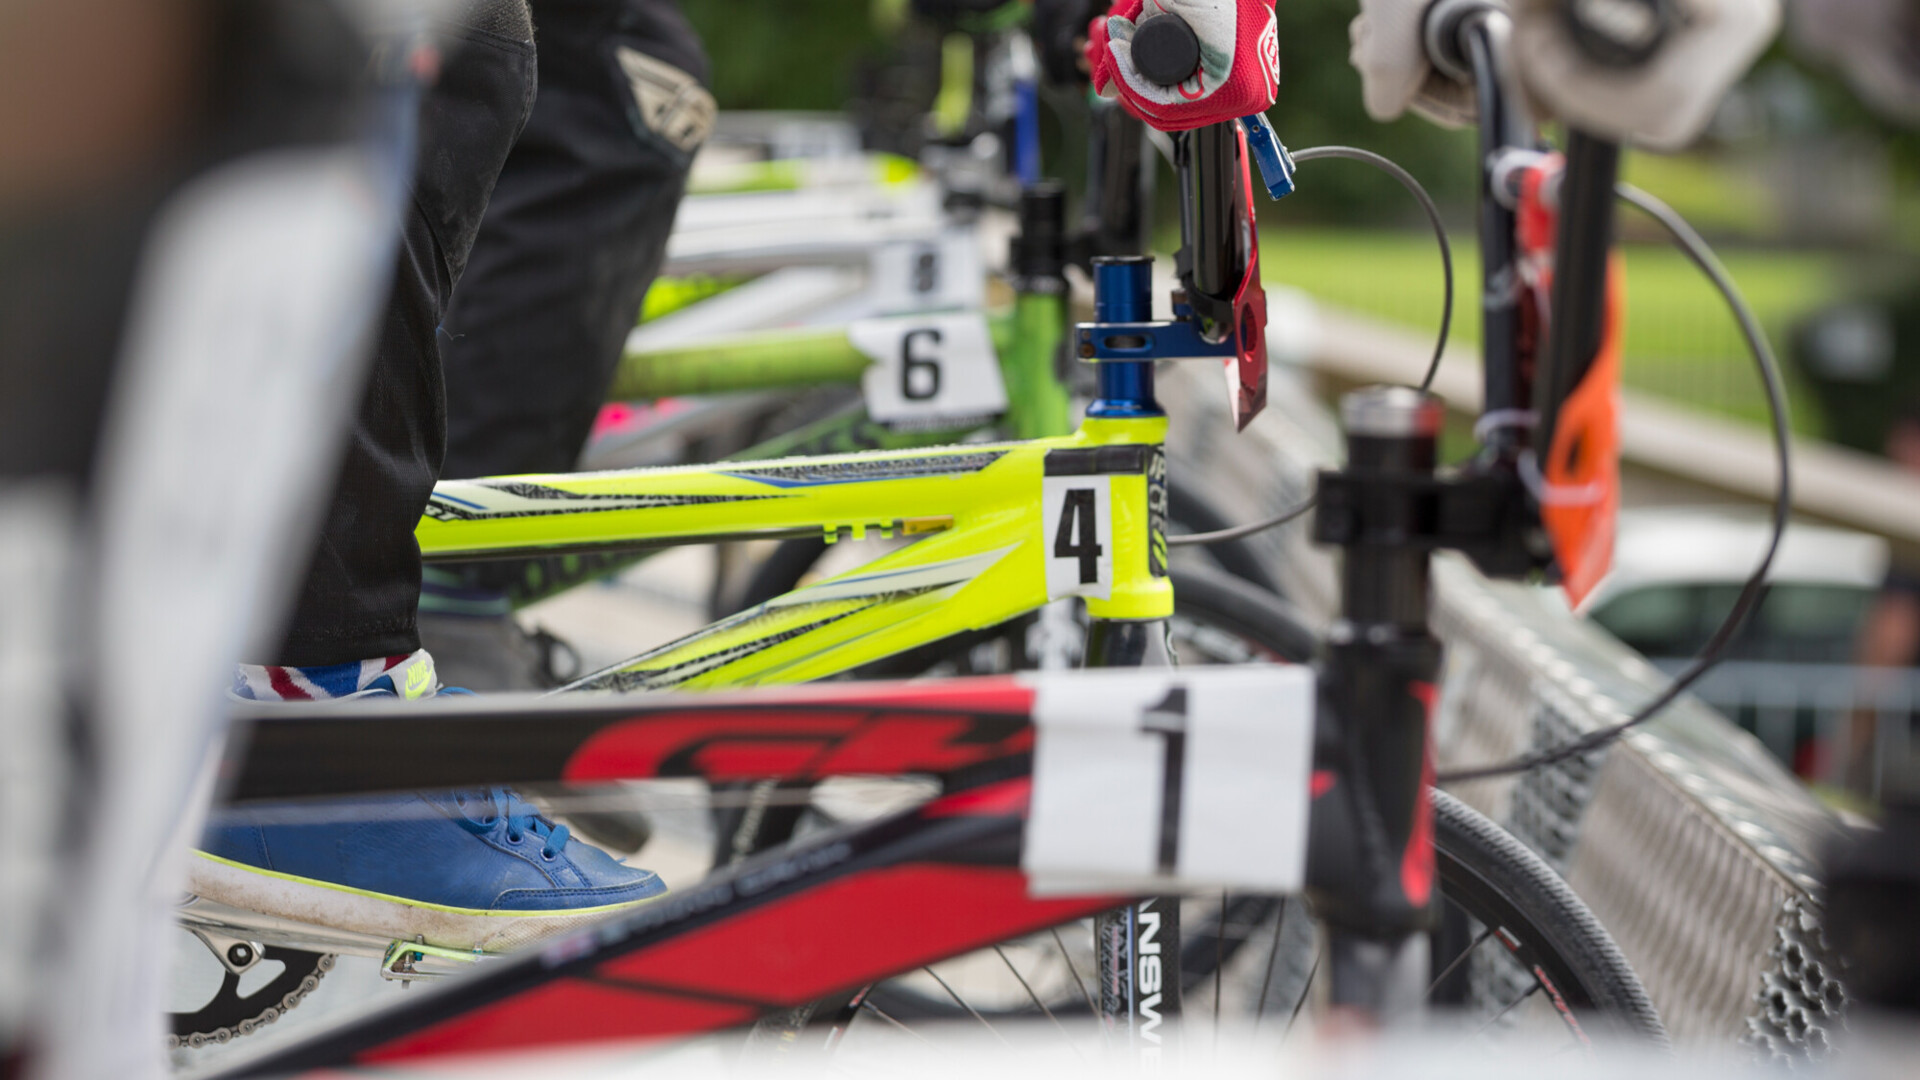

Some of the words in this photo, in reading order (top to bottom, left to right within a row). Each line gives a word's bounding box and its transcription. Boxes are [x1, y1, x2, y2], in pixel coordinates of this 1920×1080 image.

[902, 328, 942, 401] 6
[1054, 487, 1102, 585] 4
[407, 659, 428, 688] NIKE
[1138, 684, 1189, 876] 1
